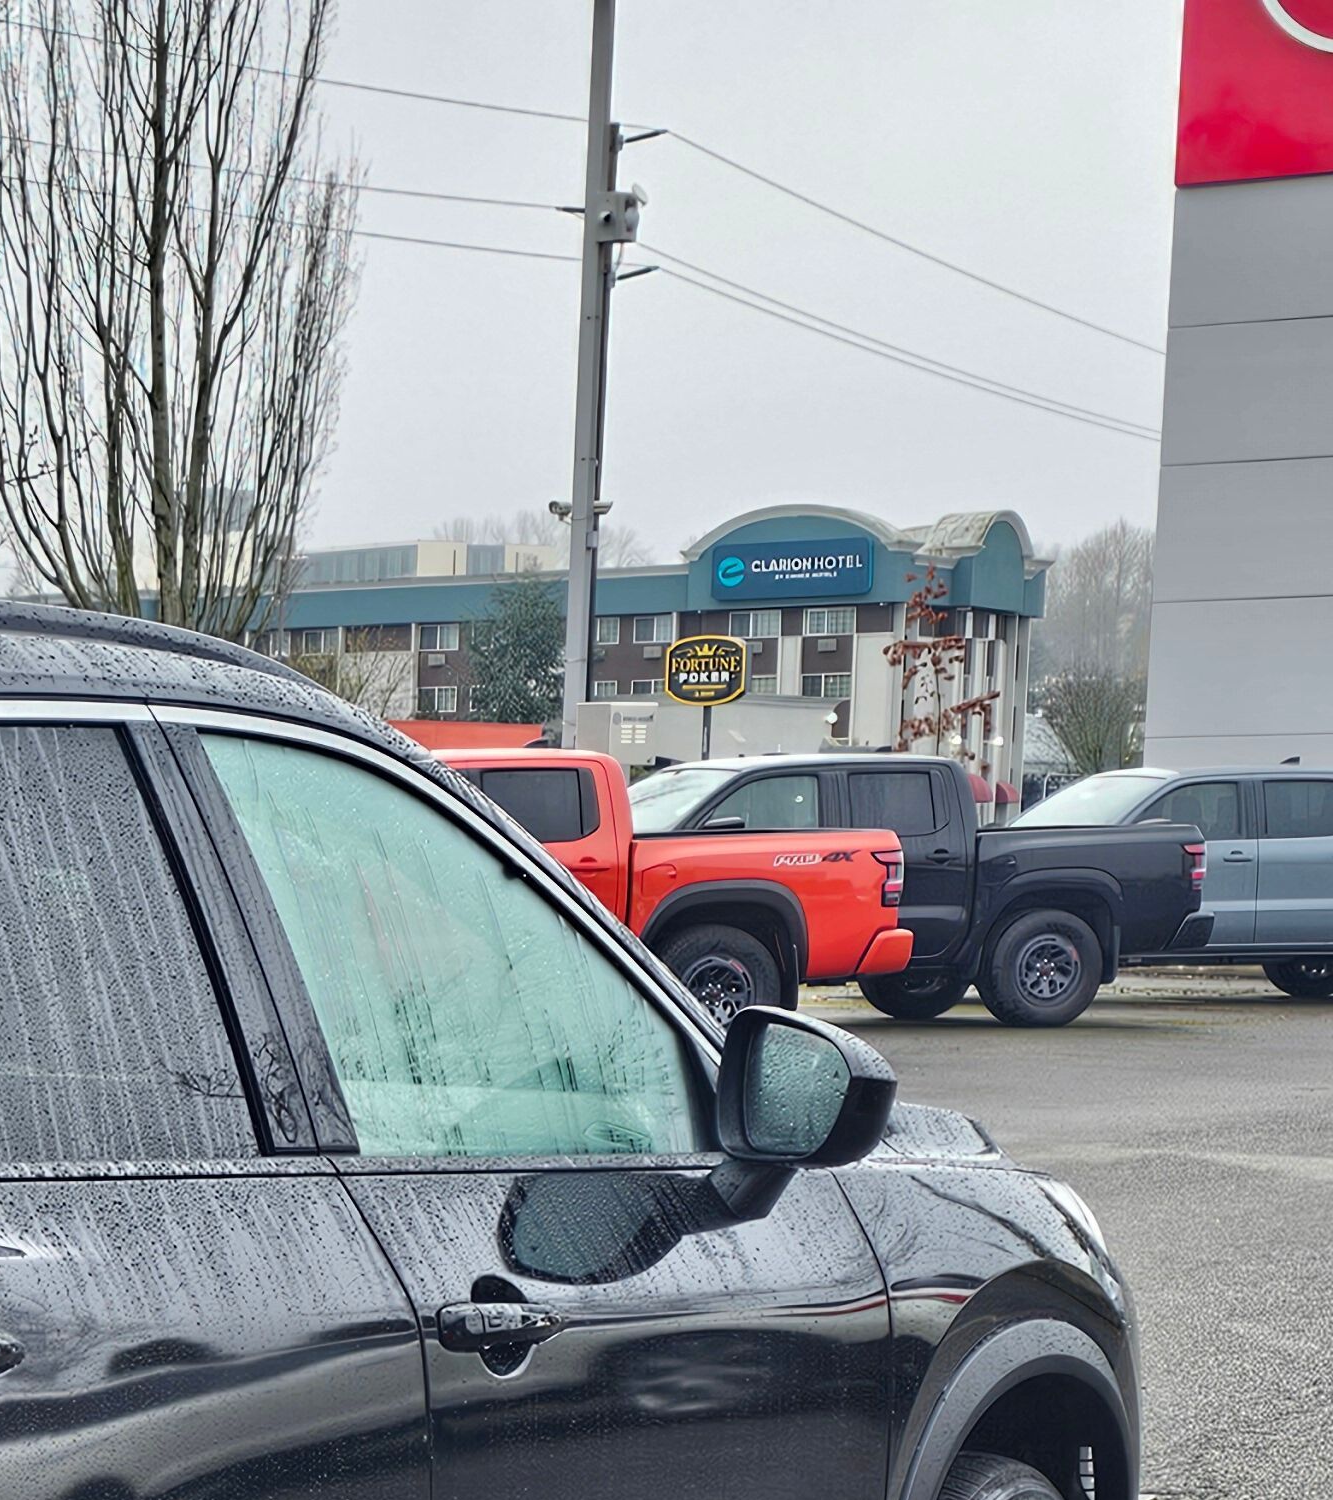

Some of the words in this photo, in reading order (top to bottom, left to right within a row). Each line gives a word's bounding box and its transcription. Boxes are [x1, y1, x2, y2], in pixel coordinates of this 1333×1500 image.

[751, 556, 812, 573] CLARION
[814, 554, 863, 570] HOTEL
[671, 656, 740, 673] FORTUNE
[679, 671, 730, 683] POKER
